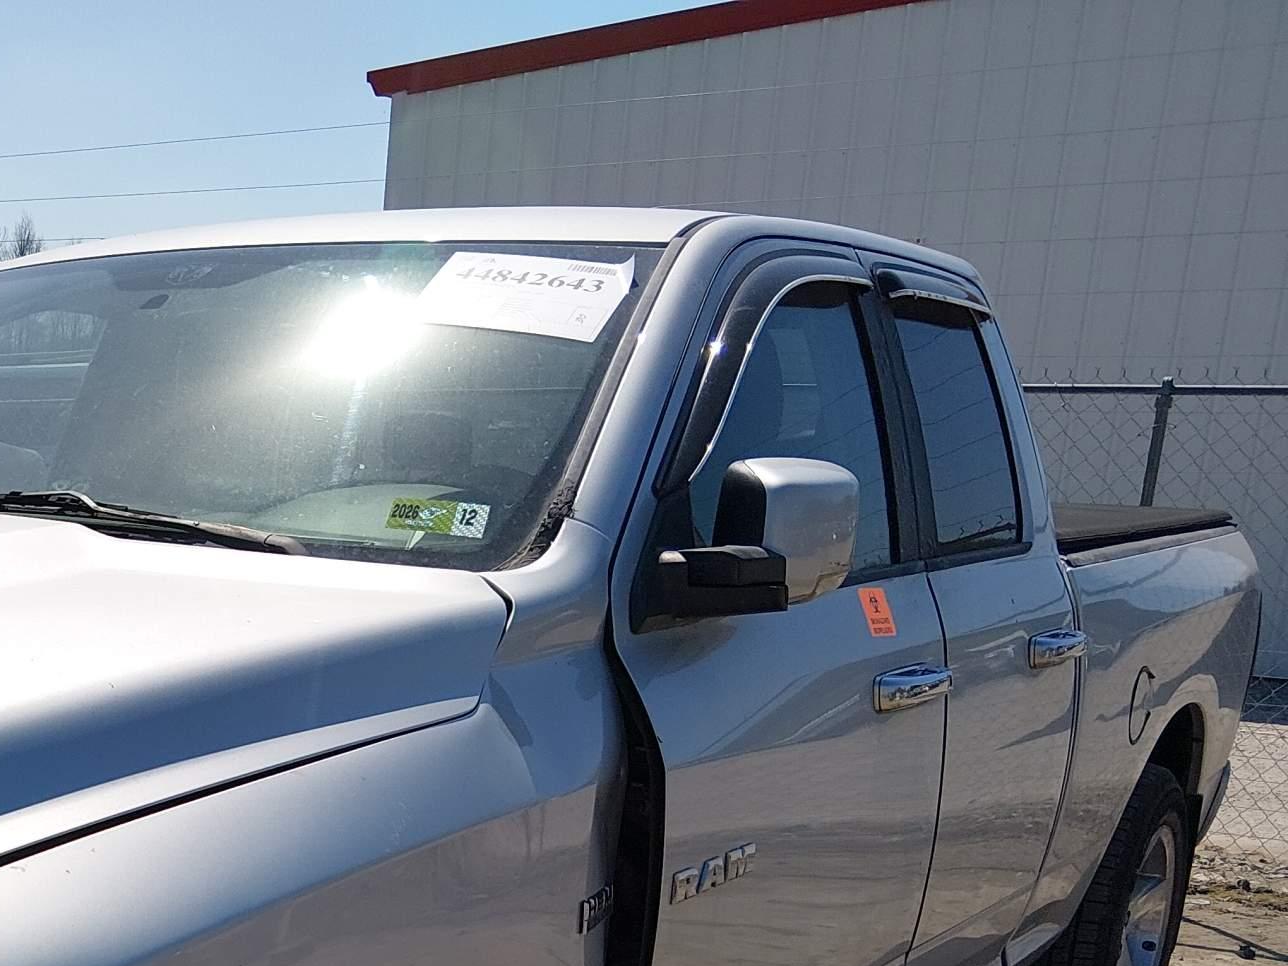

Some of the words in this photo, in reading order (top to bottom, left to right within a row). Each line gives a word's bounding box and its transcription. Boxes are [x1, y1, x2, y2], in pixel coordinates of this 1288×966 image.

[456, 266, 605, 293] 44842643
[391, 503, 421, 519] 2026
[459, 508, 479, 527] 12
[670, 842, 756, 905] RAM
